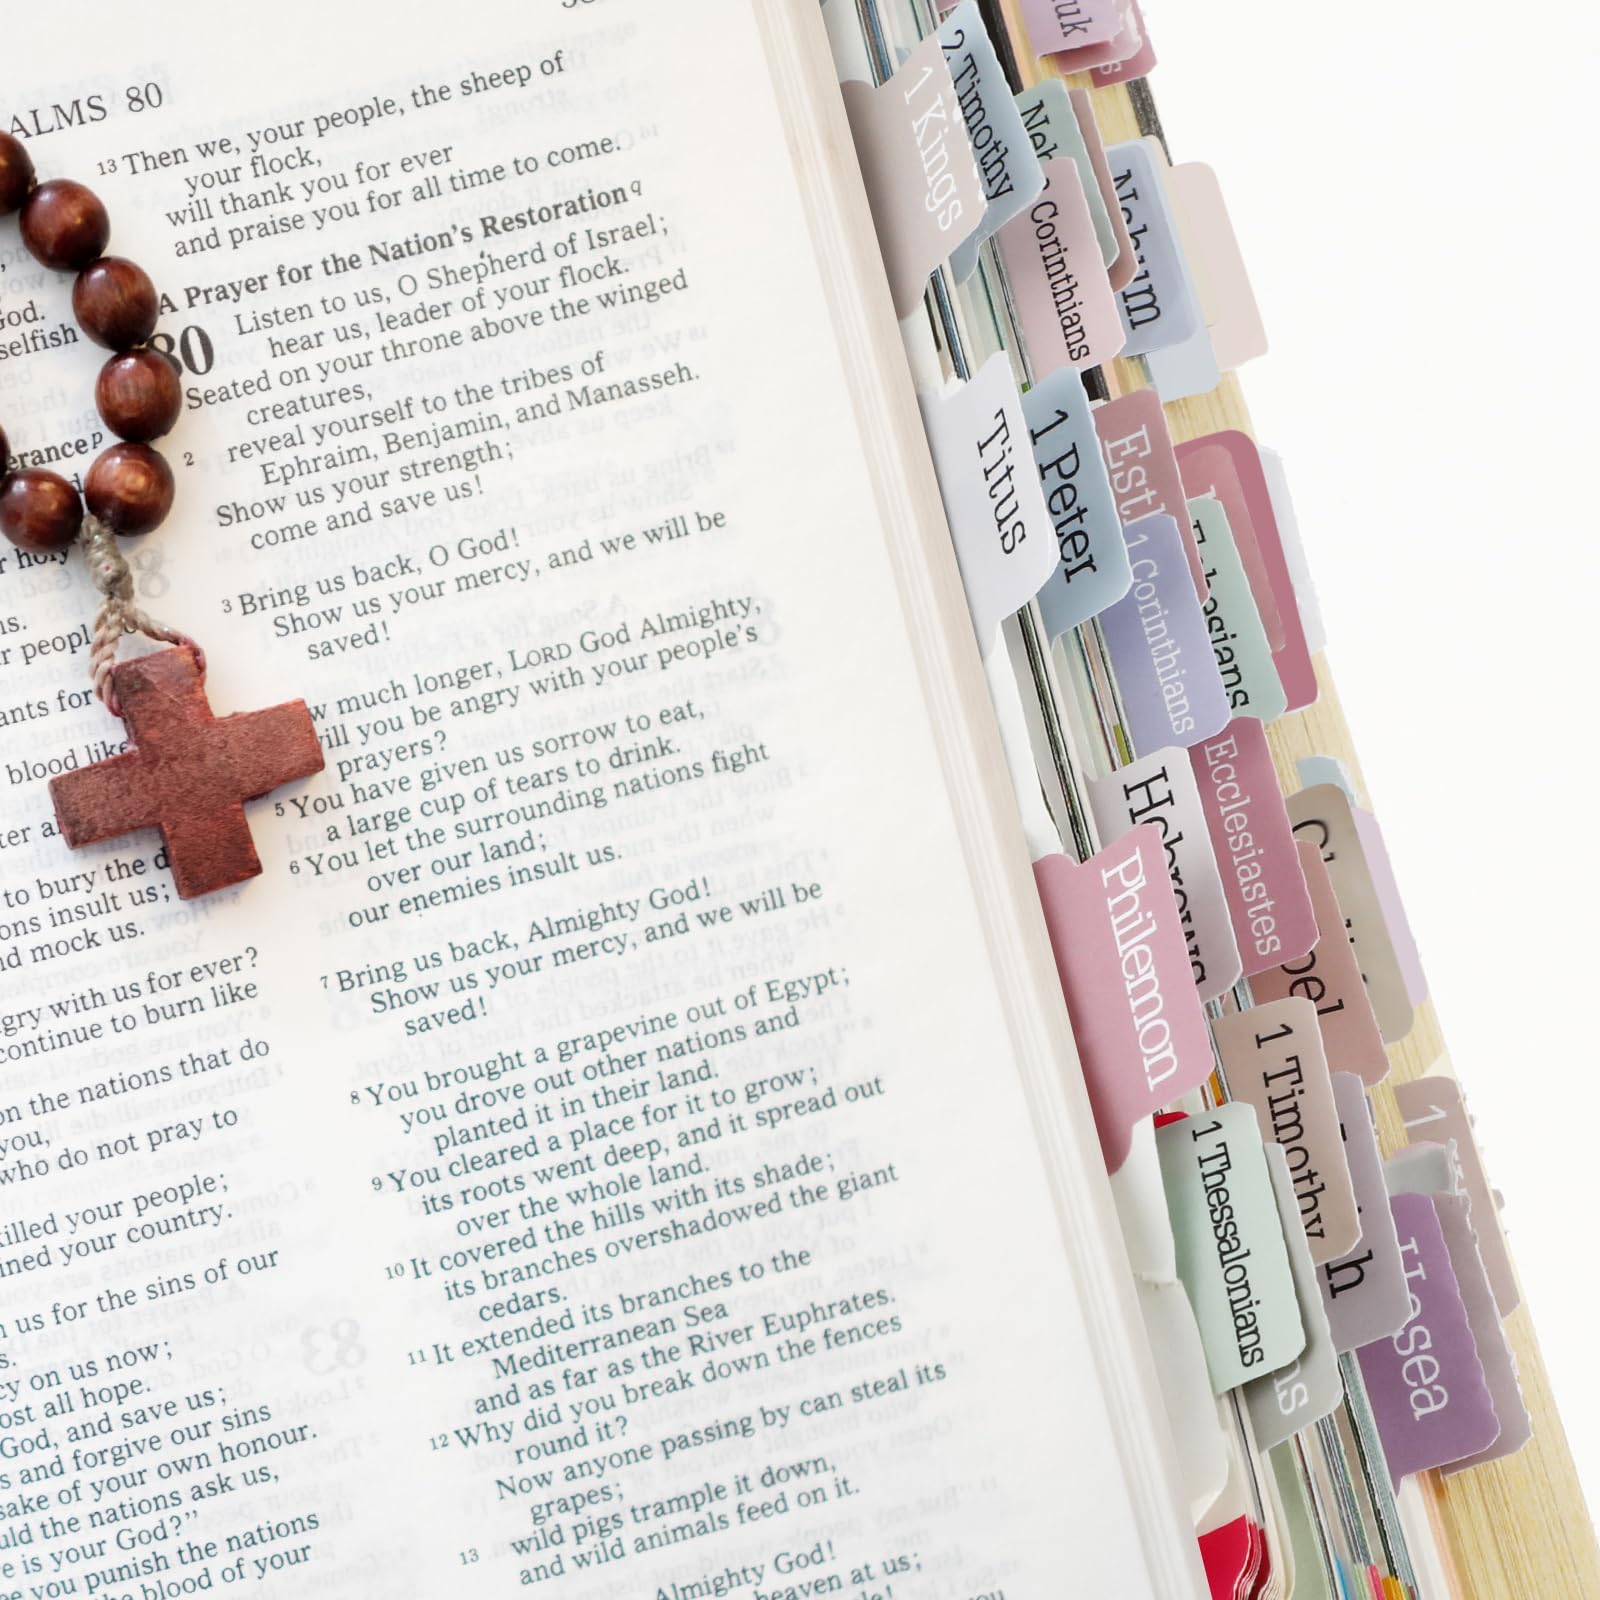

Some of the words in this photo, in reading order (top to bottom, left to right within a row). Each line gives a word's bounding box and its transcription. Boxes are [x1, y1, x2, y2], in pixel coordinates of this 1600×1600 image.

[97, 157, 118, 176] 13
[121, 148, 190, 175] Then
[194, 138, 241, 159] we,
[246, 120, 305, 153] your
[312, 96, 405, 138] people,
[410, 84, 452, 109] the
[459, 64, 532, 96] sheep
[539, 49, 565, 76] of
[125, 82, 163, 113] 80
[904, 66, 933, 105] 1
[954, 53, 1014, 200] Timothy
[174, 226, 222, 258] and
[227, 214, 305, 250] praise
[311, 201, 361, 231] you
[366, 190, 403, 213] for
[411, 175, 443, 202] all
[448, 164, 506, 193] time
[512, 156, 539, 176] to
[547, 137, 621, 168] come.
[912, 93, 963, 231] Kings
[159, 292, 179, 316] A
[183, 274, 269, 309] Prayer
[275, 263, 313, 287] for
[320, 253, 363, 277] the
[480, 186, 628, 239] Restoration
[233, 303, 314, 336] Listen
[320, 296, 346, 315] to
[353, 287, 391, 307] us,
[397, 274, 418, 297] O
[426, 241, 547, 290] Shepherd
[553, 231, 578, 258] of
[584, 213, 668, 251] Israel;
[1031, 201, 1090, 361] Corinthians
[146, 325, 214, 376] 80
[186, 369, 272, 410] Seated
[279, 366, 311, 387] on
[316, 350, 374, 384] your
[380, 330, 463, 363] throne
[470, 310, 543, 342] above
[549, 298, 590, 322] the
[595, 267, 689, 309] winged
[183, 451, 195, 467] 2
[227, 424, 306, 463] reveal
[311, 396, 414, 447] yourself
[421, 395, 447, 415] to
[453, 383, 494, 407] the
[500, 365, 573, 396] tribes
[581, 350, 605, 376] of
[259, 445, 378, 486] Ephraim,
[382, 413, 510, 455] Benjamin,
[515, 393, 562, 424] and
[565, 362, 700, 411] Manasseh.
[1030, 409, 1070, 446] 1
[977, 408, 1027, 555] Titus
[1038, 442, 1097, 584] Peter
[1127, 533, 1149, 549] 1
[221, 599, 233, 614] 3
[237, 584, 311, 617] Bring
[315, 575, 346, 596] us
[351, 554, 422, 587] back,
[428, 544, 449, 567] O
[457, 527, 519, 560] God!
[336, 679, 408, 715] much
[413, 661, 502, 696] longer,
[579, 622, 631, 653] God
[640, 596, 761, 640] Almighty,
[1131, 559, 1196, 735] Corinthians
[289, 860, 301, 875] 6
[304, 850, 360, 876] You
[364, 837, 399, 862] let
[405, 828, 446, 852] the
[454, 787, 608, 840] surrounding
[613, 762, 705, 798] nations
[711, 744, 769, 773] fight
[1204, 735, 1281, 956] Ecclesiastes
[348, 903, 390, 928] our
[399, 875, 502, 915] enemies
[508, 851, 580, 887] insult
[586, 845, 622, 866] us.
[1101, 847, 1178, 1092] Philemon
[28, 1092, 70, 1116] the
[77, 1065, 173, 1105] nations
[178, 1048, 232, 1077] that
[239, 1038, 270, 1061] do
[364, 1080, 419, 1106] You
[423, 1050, 527, 1091] brought
[534, 1047, 550, 1064] a
[557, 1012, 677, 1063] grapevine
[686, 998, 726, 1023] out
[734, 984, 757, 1010] of
[764, 968, 849, 1003] Egypt;
[1255, 1023, 1293, 1049] 1
[1192, 1120, 1224, 1142] 1
[1263, 1055, 1326, 1239] Timothy
[132, 1173, 228, 1218] people;
[409, 1258, 432, 1280] It
[439, 1226, 538, 1271] covered
[544, 1220, 585, 1244] the
[591, 1202, 645, 1231] hills
[651, 1183, 708, 1214] with
[714, 1177, 745, 1199] its
[753, 1153, 834, 1188] shade;
[1198, 1141, 1265, 1368] Thessalonians
[15, 1313, 45, 1334] us
[51, 1301, 88, 1326] for
[96, 1289, 137, 1313] the
[145, 1273, 196, 1301] sins
[204, 1258, 228, 1284] of
[237, 1250, 279, 1275] our
[432, 1343, 455, 1365] It
[461, 1308, 576, 1357] extended
[582, 1303, 614, 1325] its
[618, 1271, 733, 1314] branches
[738, 1263, 765, 1282] to
[771, 1250, 811, 1273] the
[491, 1317, 676, 1380] Mediterranean
[683, 1303, 729, 1327] Sea
[66, 1411, 114, 1443] and
[120, 1400, 178, 1429] save
[185, 1387, 226, 1411] us;
[495, 1470, 553, 1500] Now
[563, 1444, 652, 1482] anyone
[660, 1416, 755, 1460] passing
[759, 1406, 790, 1427] by
[799, 1392, 843, 1416] can
[851, 1368, 909, 1403] steal
[915, 1364, 947, 1385] its
[83, 1551, 171, 1595] punish
[176, 1541, 218, 1566] the
[225, 1513, 320, 1553] nations
[510, 1523, 565, 1556] wild
[571, 1513, 624, 1546] pigs
[630, 1482, 727, 1524] trample
[734, 1475, 753, 1496] it
[760, 1457, 836, 1488] down,
